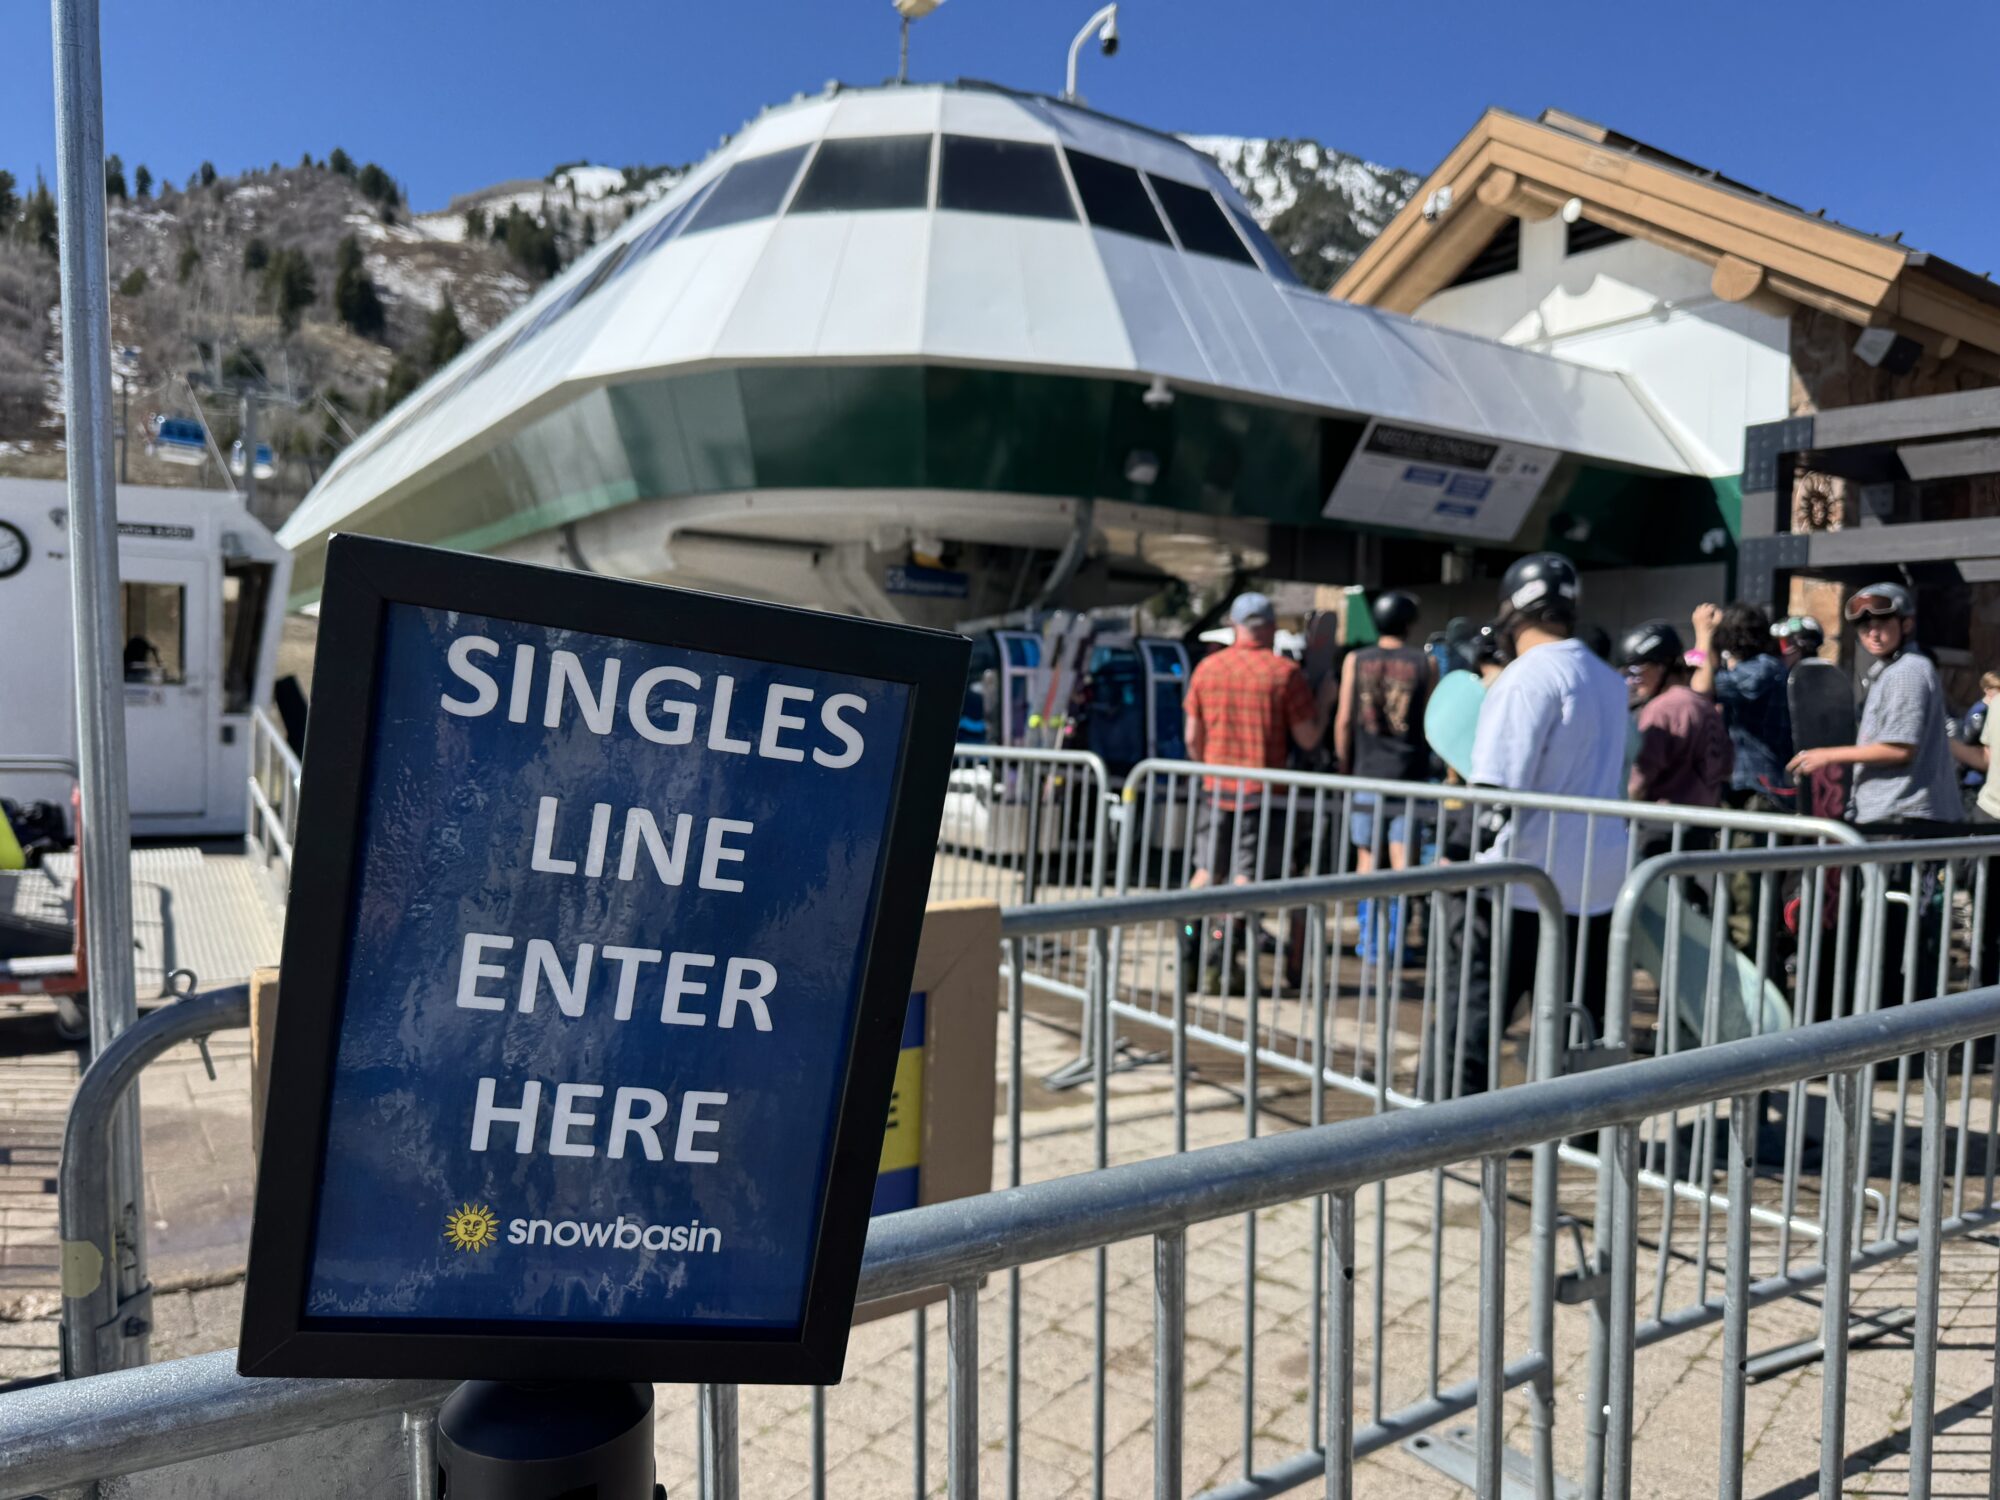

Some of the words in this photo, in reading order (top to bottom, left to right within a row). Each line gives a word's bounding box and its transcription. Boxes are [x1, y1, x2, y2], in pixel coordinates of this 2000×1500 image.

[441, 635, 868, 769] SINGLES
[530, 795, 755, 894] LINE
[455, 931, 778, 1033] ENTER
[469, 1077, 729, 1165] HERE
[507, 1215, 722, 1254] snowbasin
